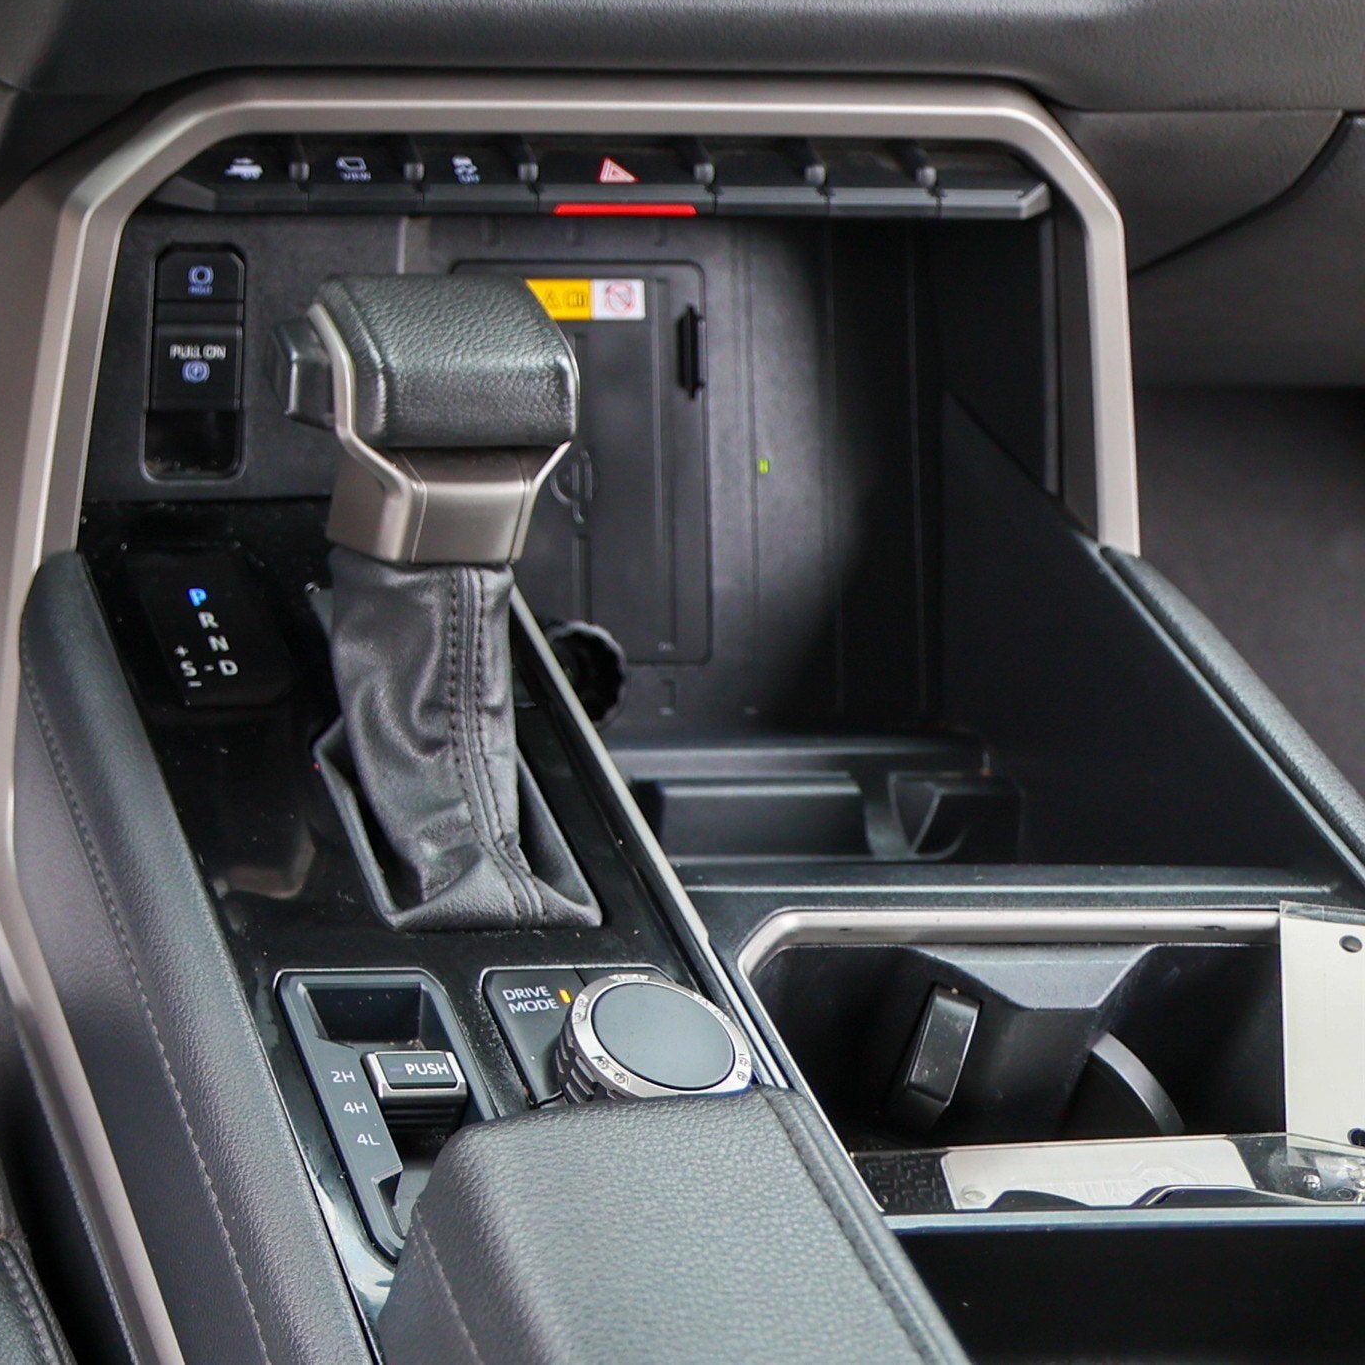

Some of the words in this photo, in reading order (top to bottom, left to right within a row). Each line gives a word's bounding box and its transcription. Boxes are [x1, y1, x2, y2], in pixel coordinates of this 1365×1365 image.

[170, 344, 200, 359] PULL
[203, 344, 226, 360] ON
[189, 588, 207, 607] P
[198, 611, 219, 629] R
[208, 635, 229, 652] N
[180, 660, 197, 677] S
[218, 659, 238, 676] D
[502, 985, 552, 1002] DRIVE
[508, 998, 559, 1014] MODE
[331, 1070, 356, 1084] 2H
[405, 1061, 449, 1078] PUSH
[343, 1100, 368, 1115] 4H
[356, 1133, 381, 1147] 4L
